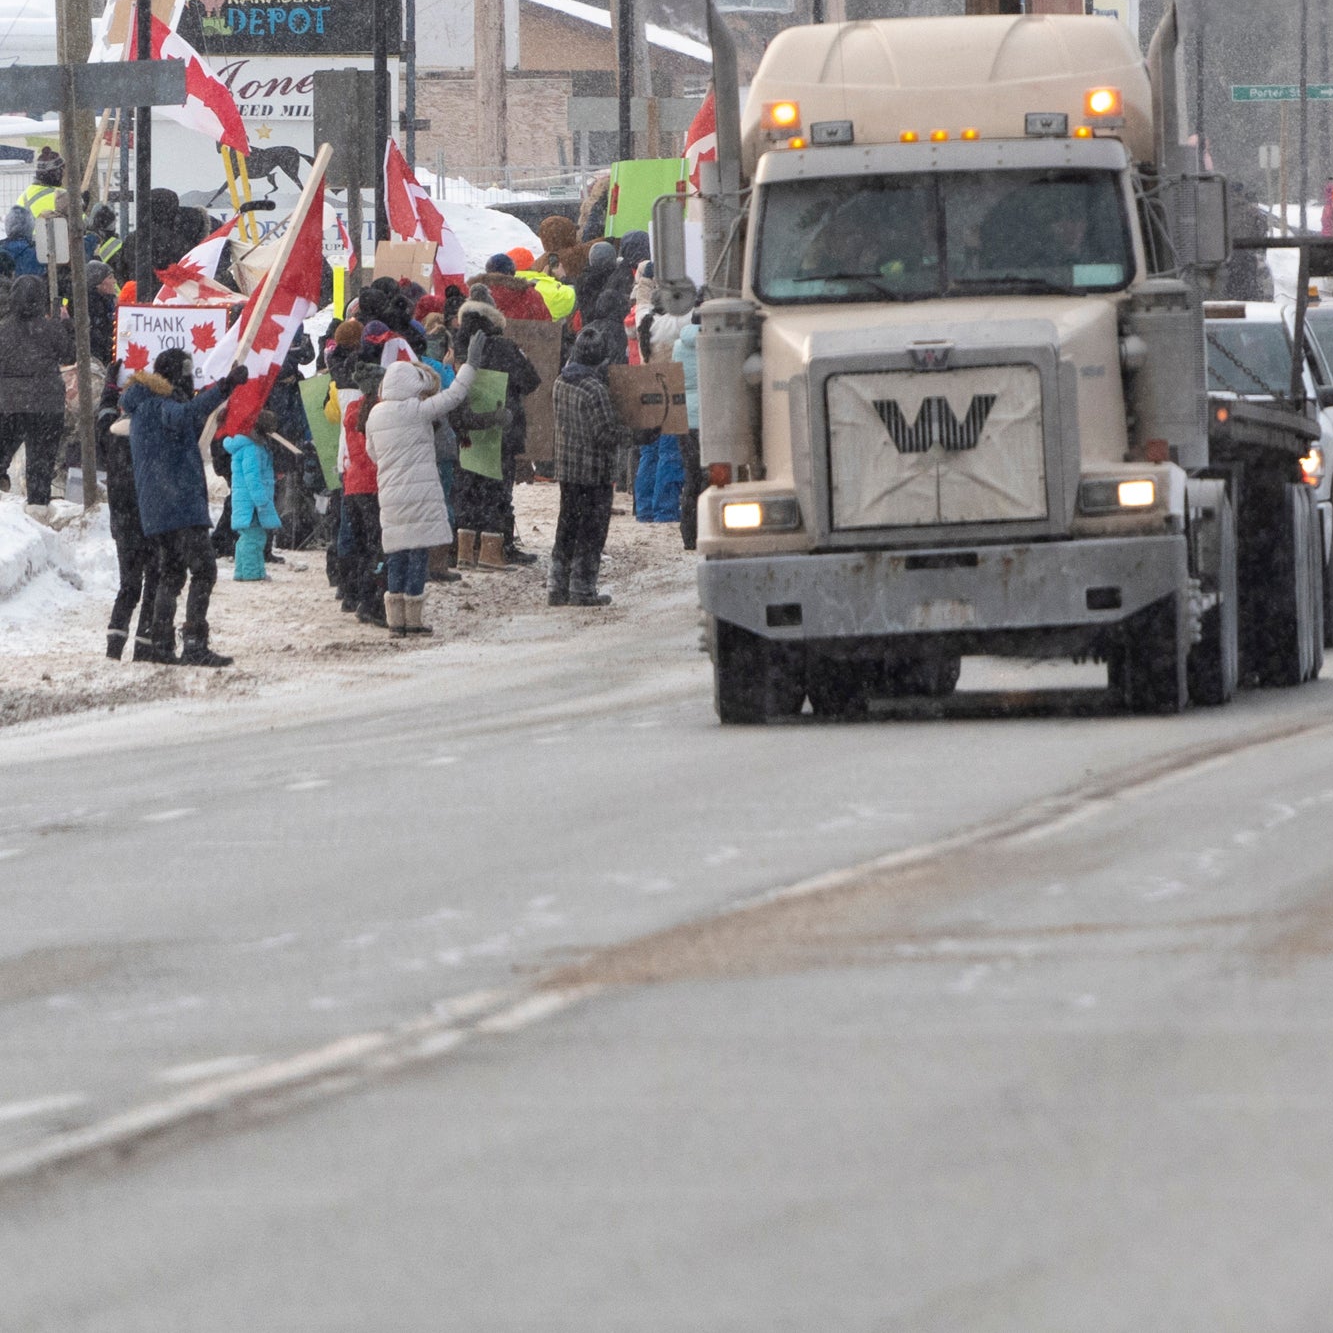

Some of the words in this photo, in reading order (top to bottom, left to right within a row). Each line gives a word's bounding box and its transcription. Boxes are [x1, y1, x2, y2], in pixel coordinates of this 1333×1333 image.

[227, 6, 331, 35] DEPOT
[131, 314, 185, 333] THANK
[157, 335, 186, 350] YOU
